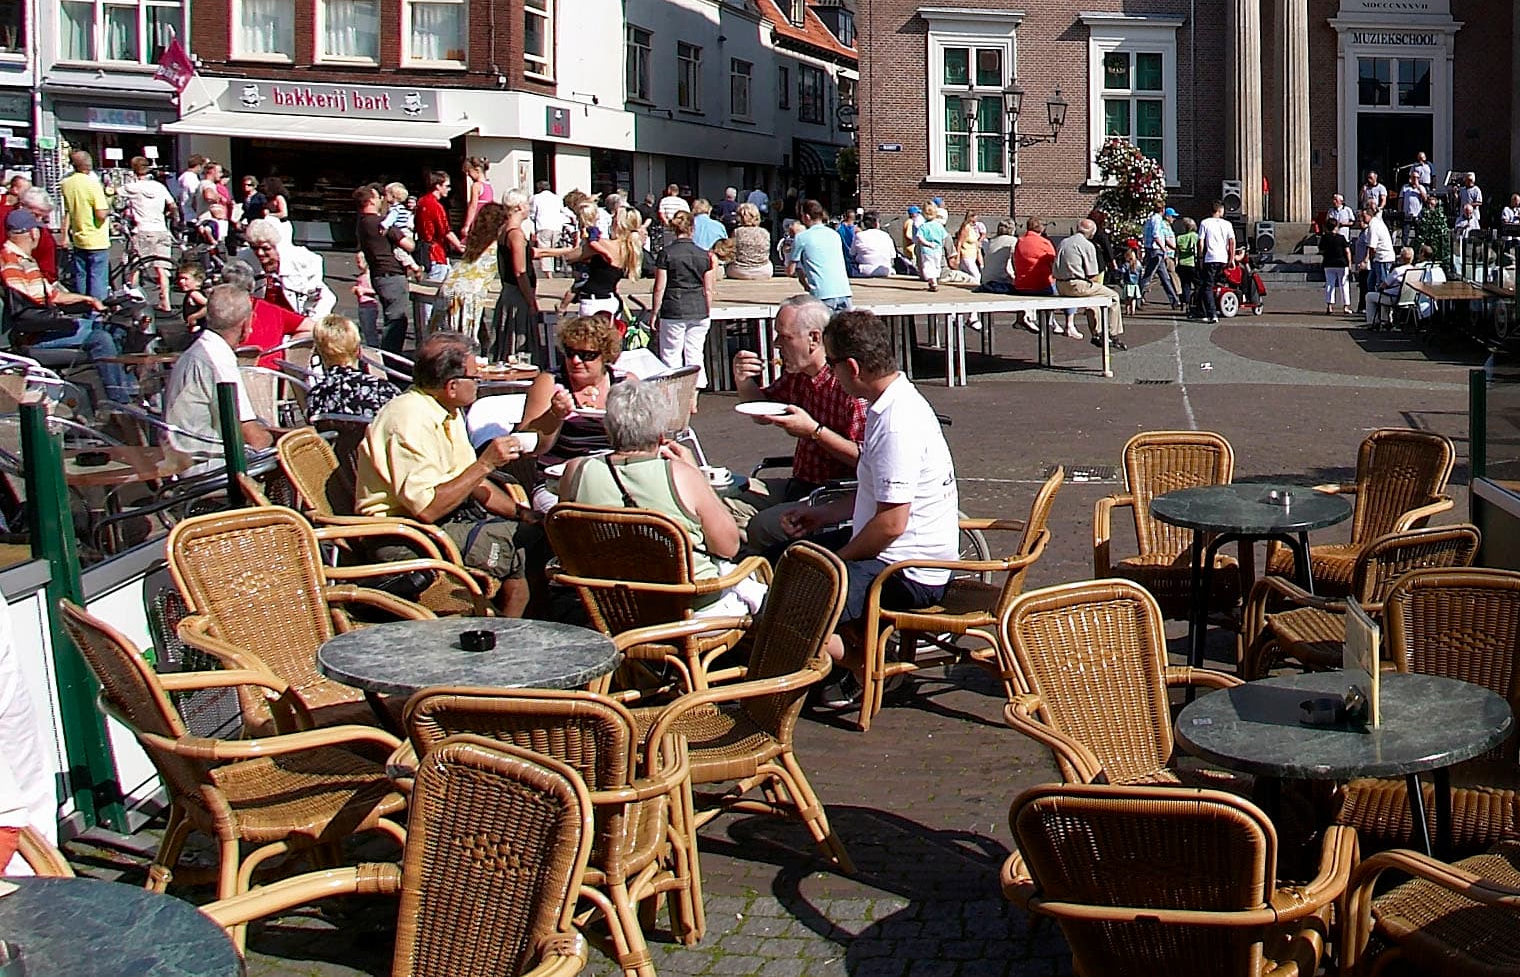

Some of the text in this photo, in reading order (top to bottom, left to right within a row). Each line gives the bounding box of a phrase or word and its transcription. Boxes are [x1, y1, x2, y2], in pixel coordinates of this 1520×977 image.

[1353, 32, 1437, 46] MUZIEKSCHOOL
[272, 85, 392, 112] bakkerij bart
